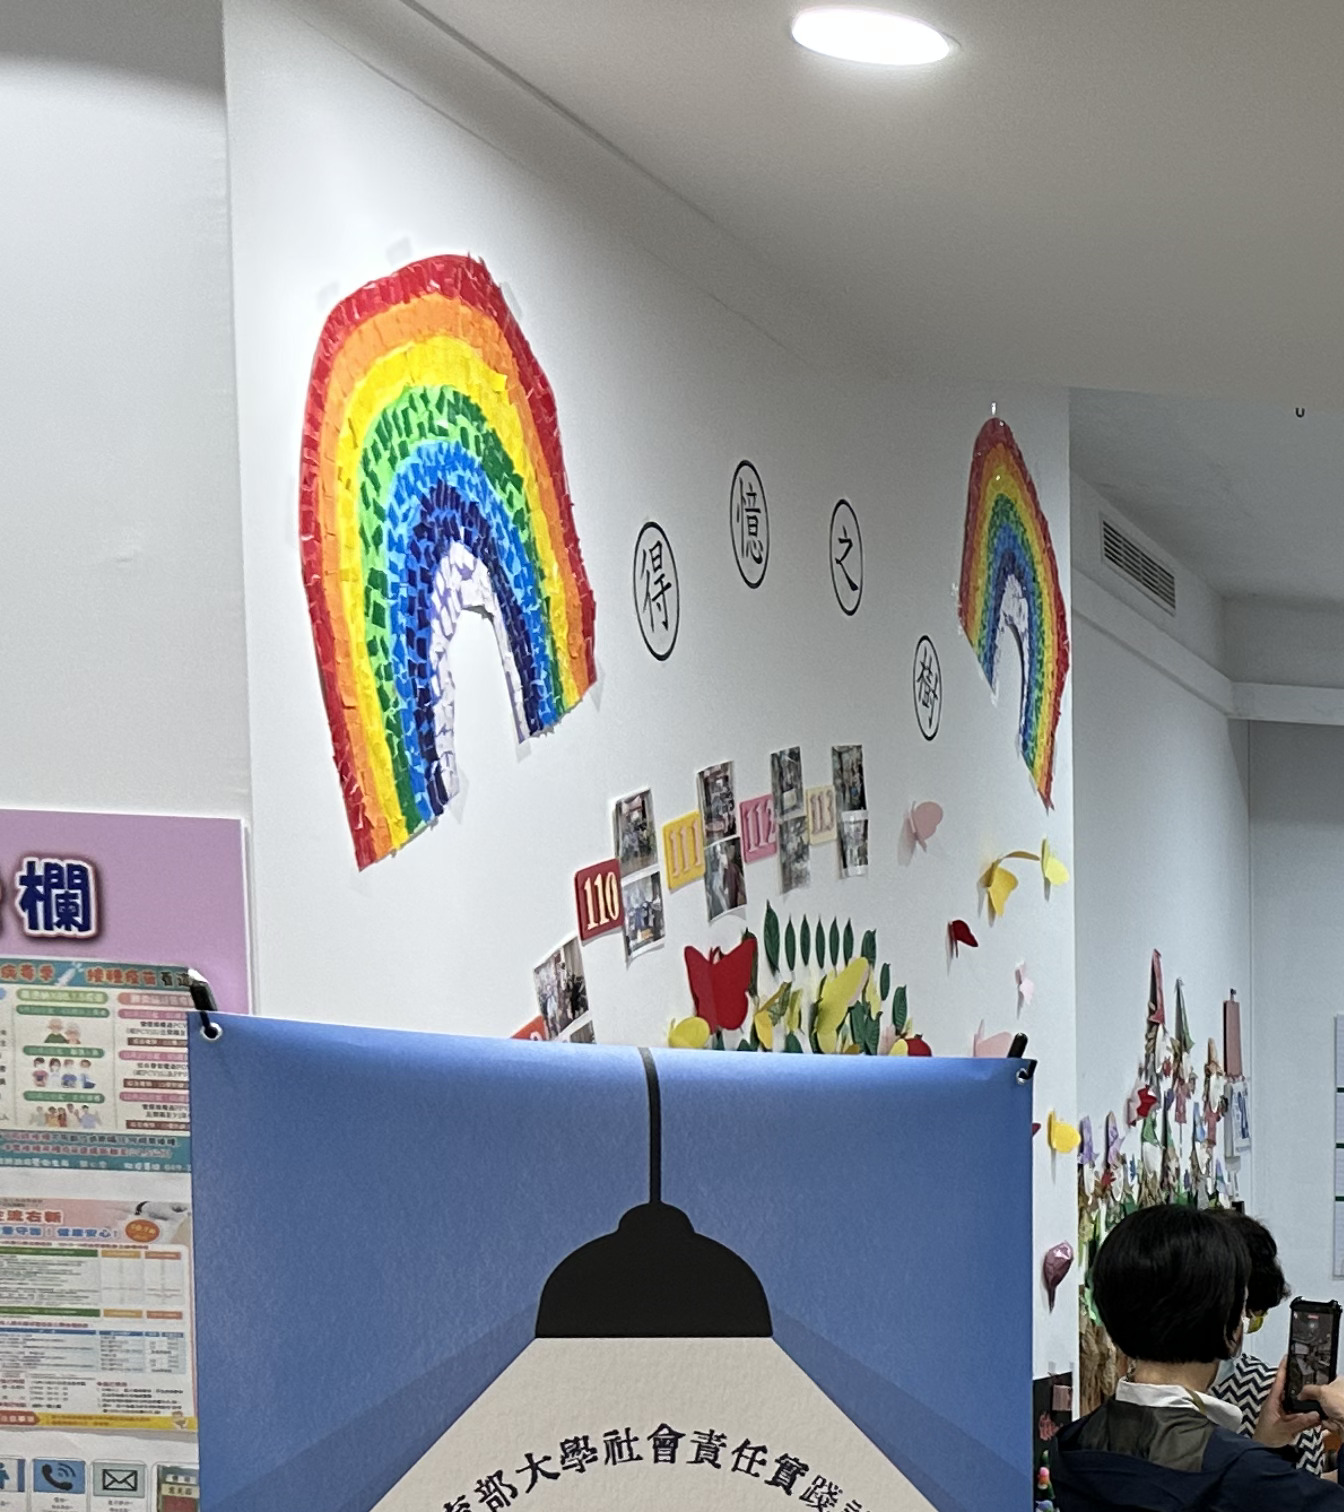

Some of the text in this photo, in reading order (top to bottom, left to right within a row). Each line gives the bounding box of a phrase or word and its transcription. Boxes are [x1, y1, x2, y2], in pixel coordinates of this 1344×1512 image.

[641, 540, 672, 633] 得
[736, 476, 764, 565] 憶
[835, 525, 859, 592] 之
[669, 818, 703, 878] 111
[17, 857, 93, 933] 欄
[584, 871, 620, 931] 110
